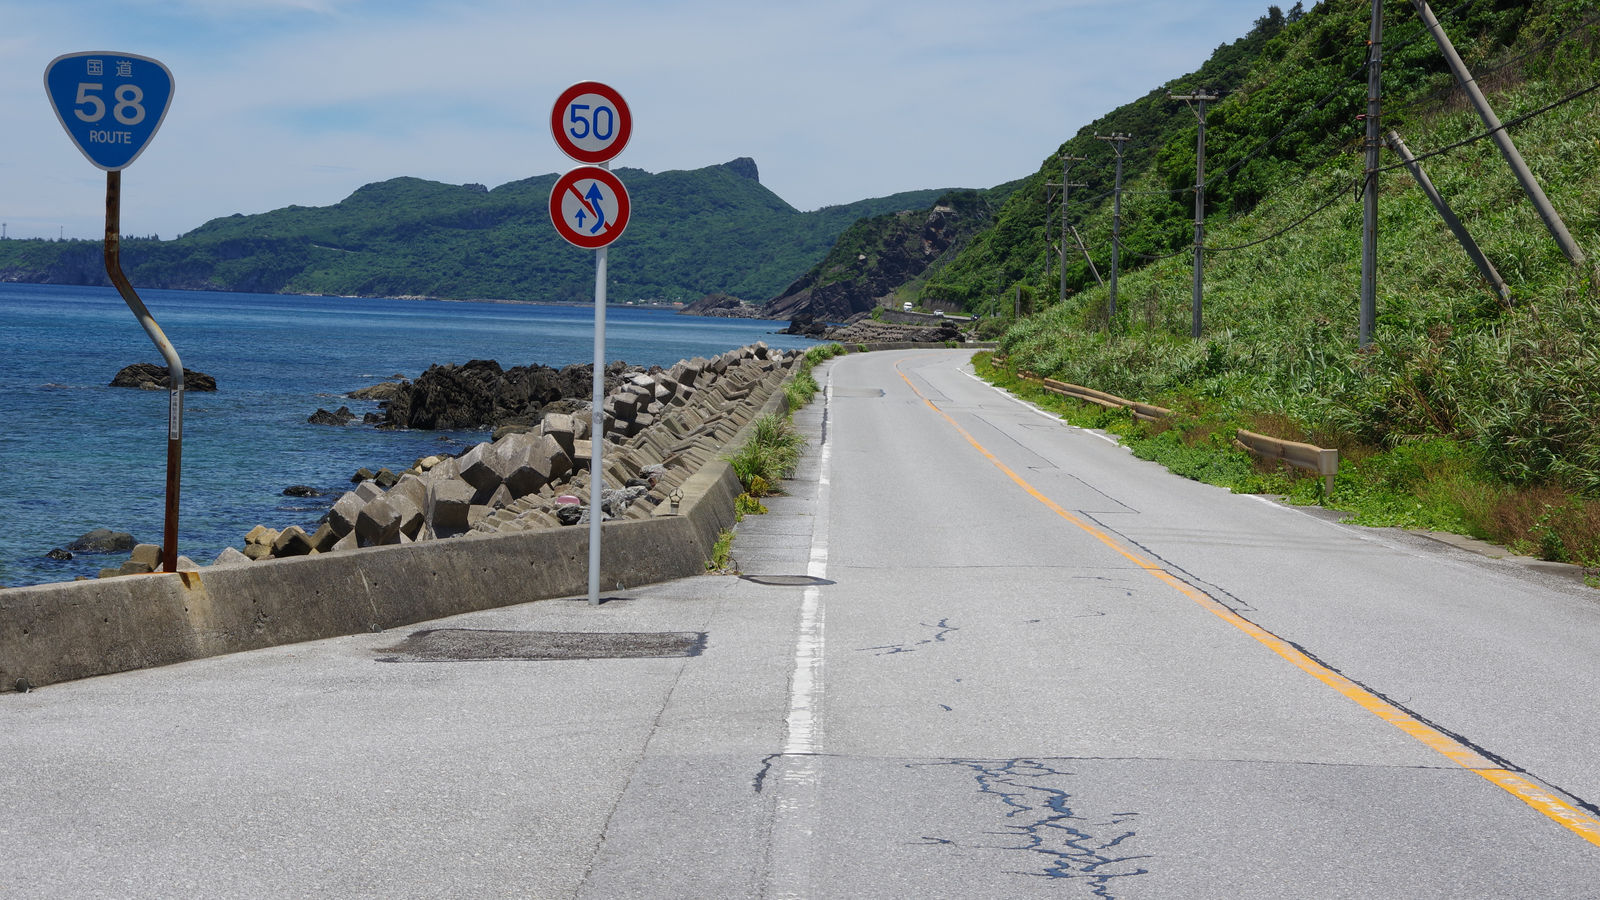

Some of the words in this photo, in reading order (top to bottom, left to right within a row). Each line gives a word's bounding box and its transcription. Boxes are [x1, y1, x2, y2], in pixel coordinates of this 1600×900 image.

[86, 59, 133, 77] 国道
[74, 82, 146, 126] 58
[570, 104, 614, 140] 50
[89, 130, 132, 144] ROUTE
